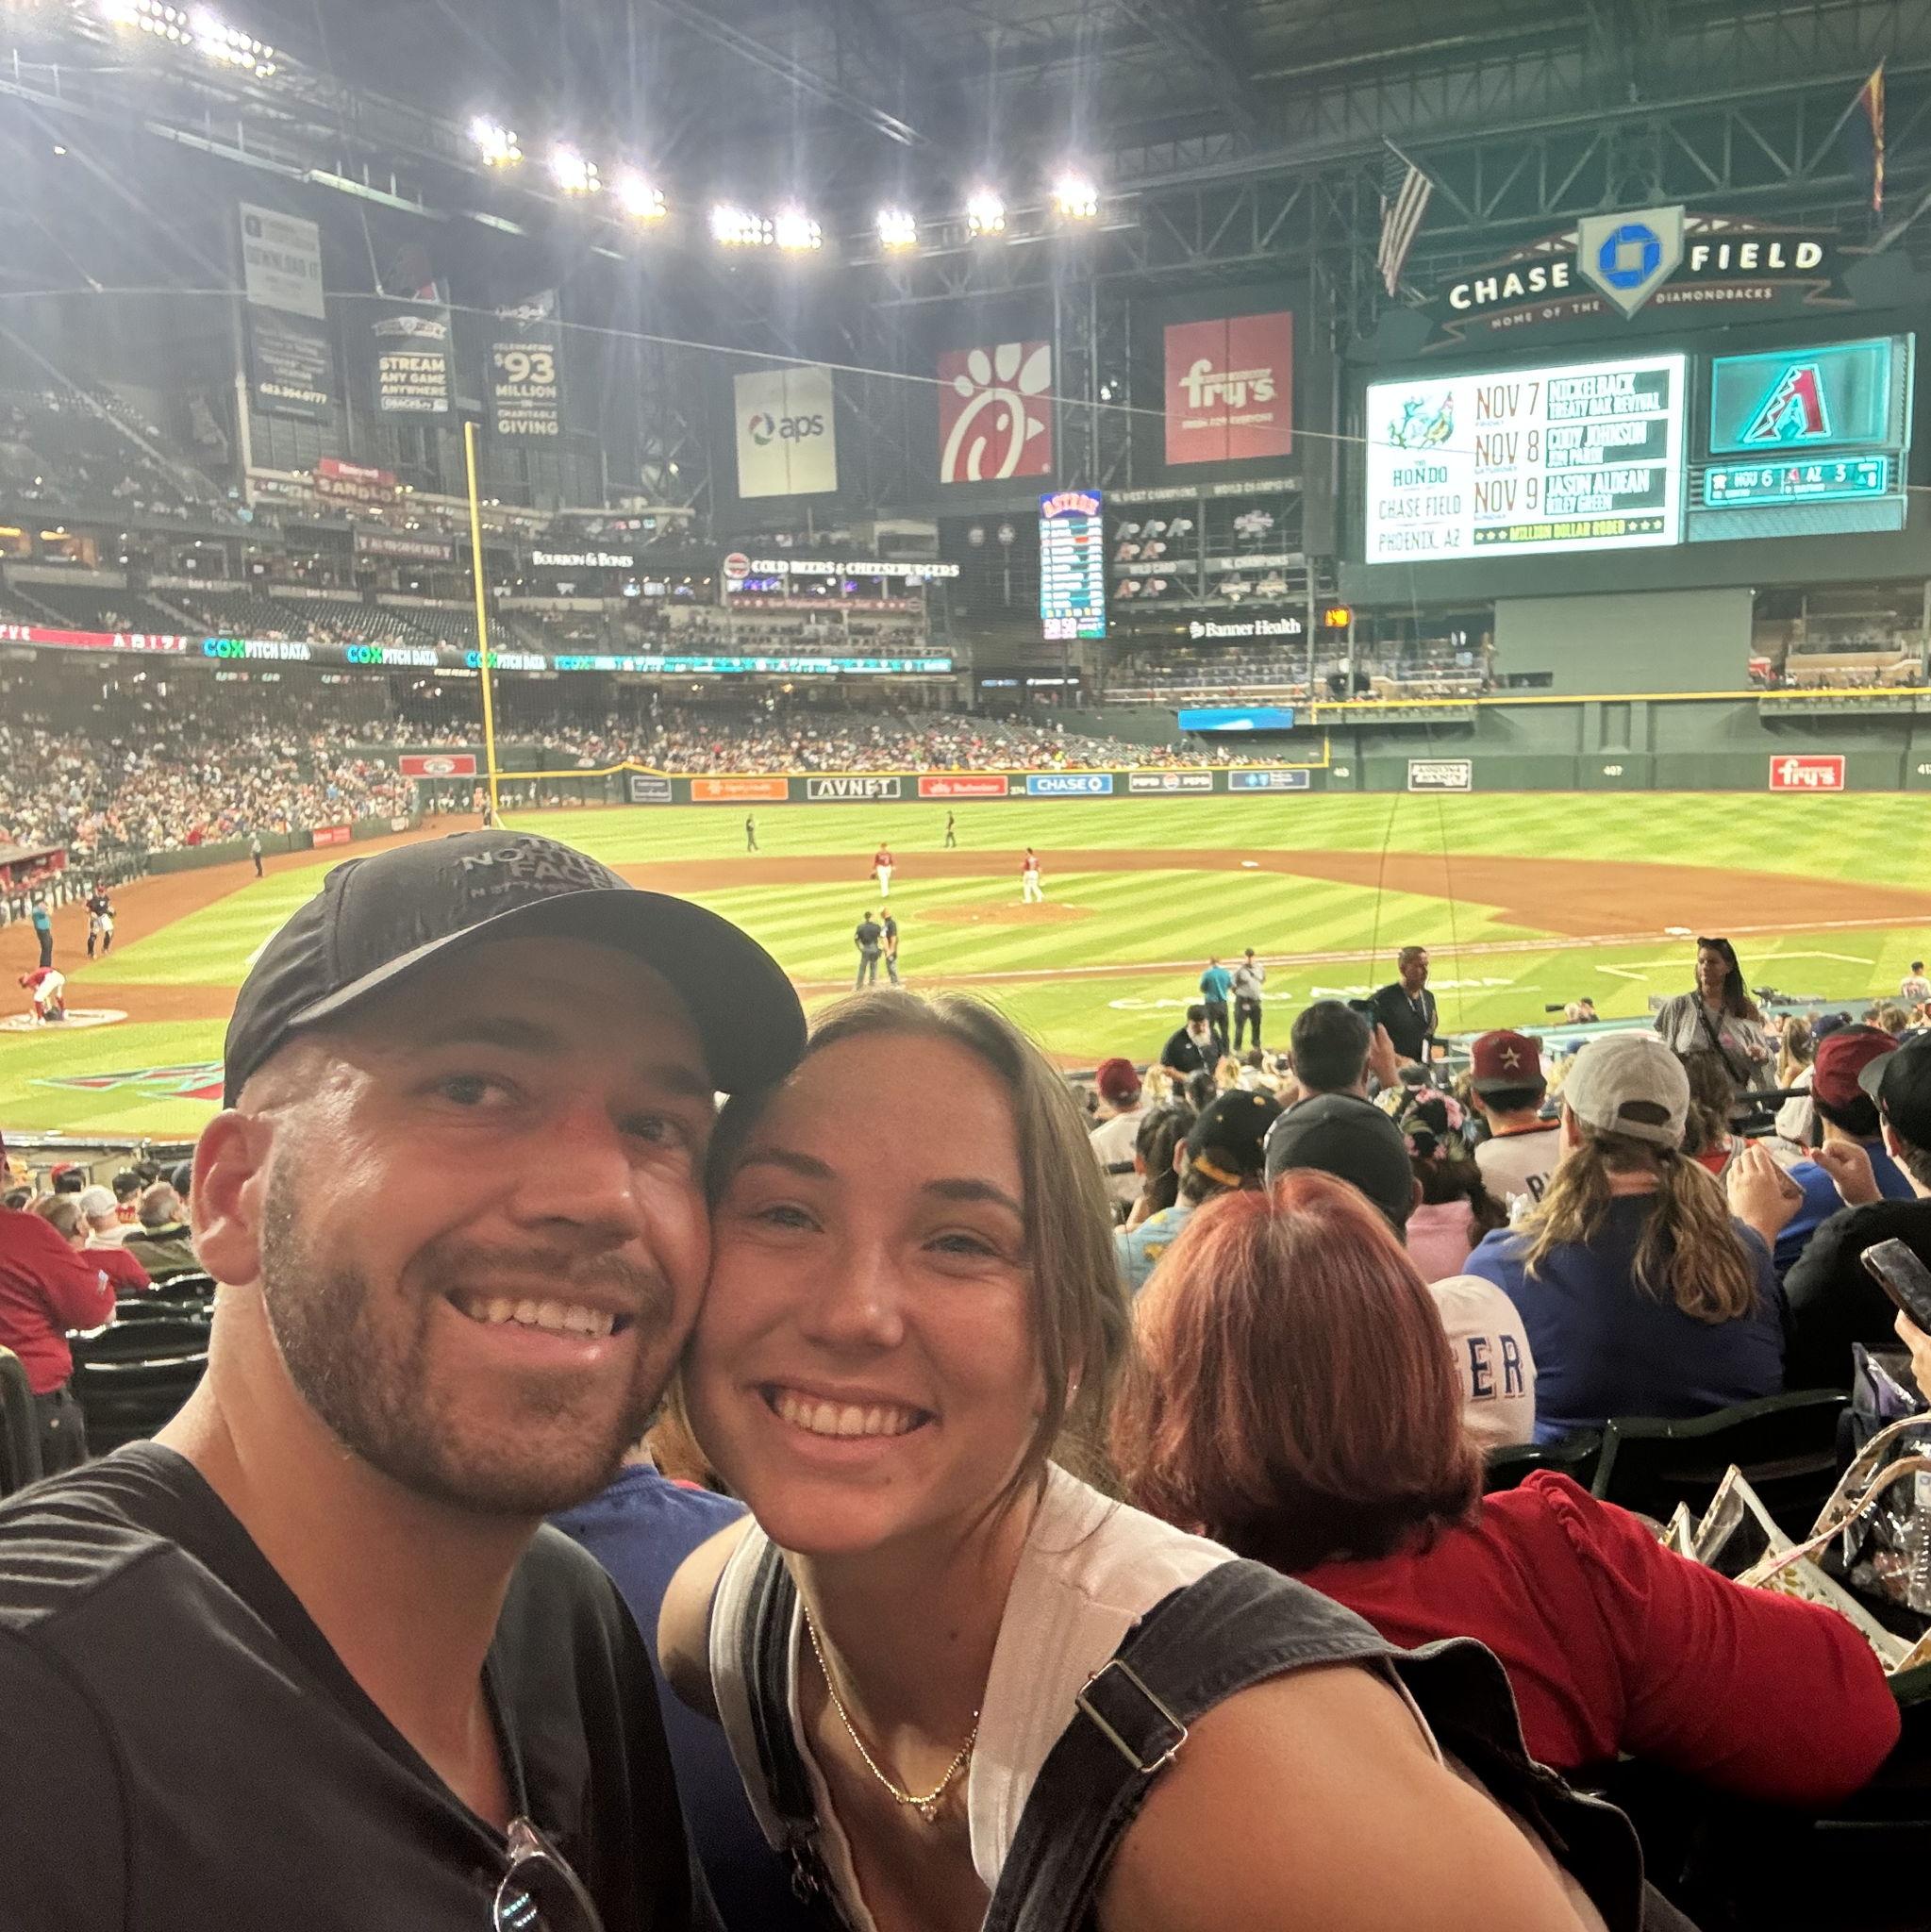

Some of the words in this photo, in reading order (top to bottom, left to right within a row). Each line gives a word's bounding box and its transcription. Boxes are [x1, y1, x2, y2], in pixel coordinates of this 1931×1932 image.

[1450, 262, 1570, 309] CHASE
[1691, 242, 1823, 272] FIELD
[1491, 310, 1532, 329] HOME
[1543, 306, 1560, 320] OF
[1573, 300, 1600, 315] THE
[1656, 287, 1773, 304] DIAMONDBACKS
[379, 358, 445, 373] STREAM
[493, 352, 555, 383] $93
[380, 373, 408, 383] ANY
[410, 374, 445, 385] GAME
[381, 385, 447, 396] ANYWHERE
[1179, 358, 1276, 408] fry's
[1549, 374, 1636, 402] NICKELBACK
[495, 384, 557, 398] MILLION
[1476, 384, 1520, 420] NOV
[1528, 383, 1540, 415] 7
[1549, 399, 1589, 419] TREATY
[1614, 392, 1660, 413] REVIVAL
[498, 421, 558, 435] GIVING
[779, 413, 824, 443] aps
[1548, 426, 1584, 450] CODY
[1585, 421, 1647, 447] JOHNSON
[1475, 431, 1519, 467] NOV
[1527, 430, 1540, 462] 8
[1393, 466, 1448, 487] HONDO
[1548, 475, 1592, 496] JASON
[1593, 469, 1650, 493] ALDEAN
[1761, 469, 1773, 487] 6
[1806, 466, 1822, 482] AZ
[1474, 479, 1518, 513] NOV
[1526, 477, 1538, 509] 9
[1379, 498, 1420, 520] CHASE
[1426, 494, 1460, 516] FIELD
[1444, 529, 1459, 547] AZ
[1510, 524, 1552, 541] MILLION
[1553, 522, 1590, 539] DOLLAR
[752, 559, 789, 574] COLD
[791, 560, 835, 575] BEERS
[836, 561, 846, 575] &
[846, 561, 960, 577] CHEESEBURGERS
[1205, 622, 1253, 637] Banner
[1255, 617, 1301, 635] Health
[203, 637, 244, 658] COX
[244, 640, 279, 659] PITCH
[280, 641, 310, 660] DATA
[346, 645, 382, 665] COX
[382, 648, 411, 665] PITCH
[413, 649, 439, 667] DATA
[497, 653, 522, 670] PITCH
[524, 654, 546, 671] DATA
[1777, 758, 1835, 786] fry's
[818, 779, 891, 796] AVNET
[1037, 778, 1087, 791] CHASE
[1451, 1335, 1525, 1402] ER
